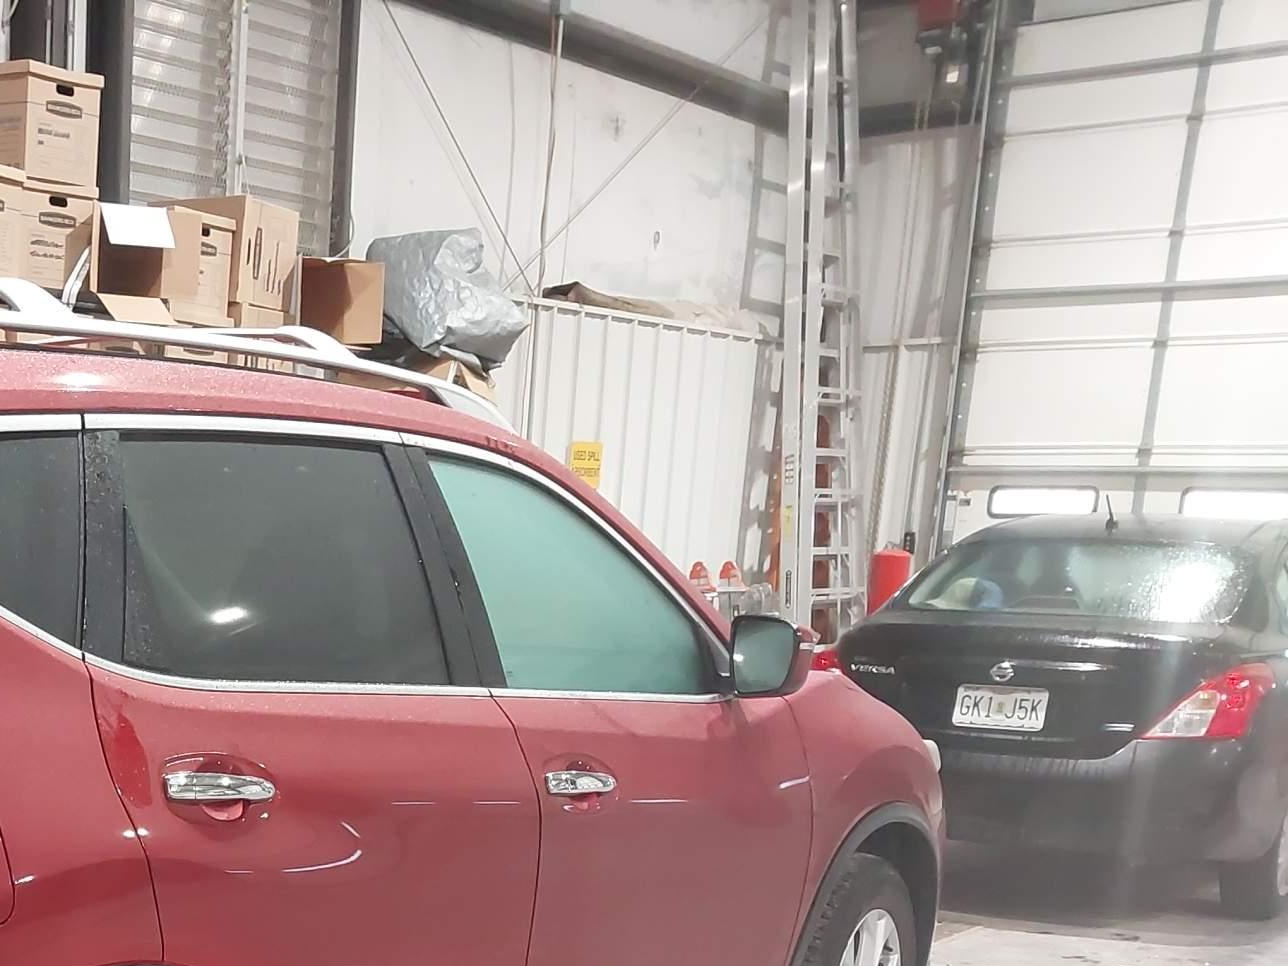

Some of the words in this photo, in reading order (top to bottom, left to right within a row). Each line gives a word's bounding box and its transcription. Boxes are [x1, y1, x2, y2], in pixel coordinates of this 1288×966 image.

[850, 663, 896, 675] VERSA
[959, 694, 992, 718] GK1
[1004, 697, 1042, 721] J5K
